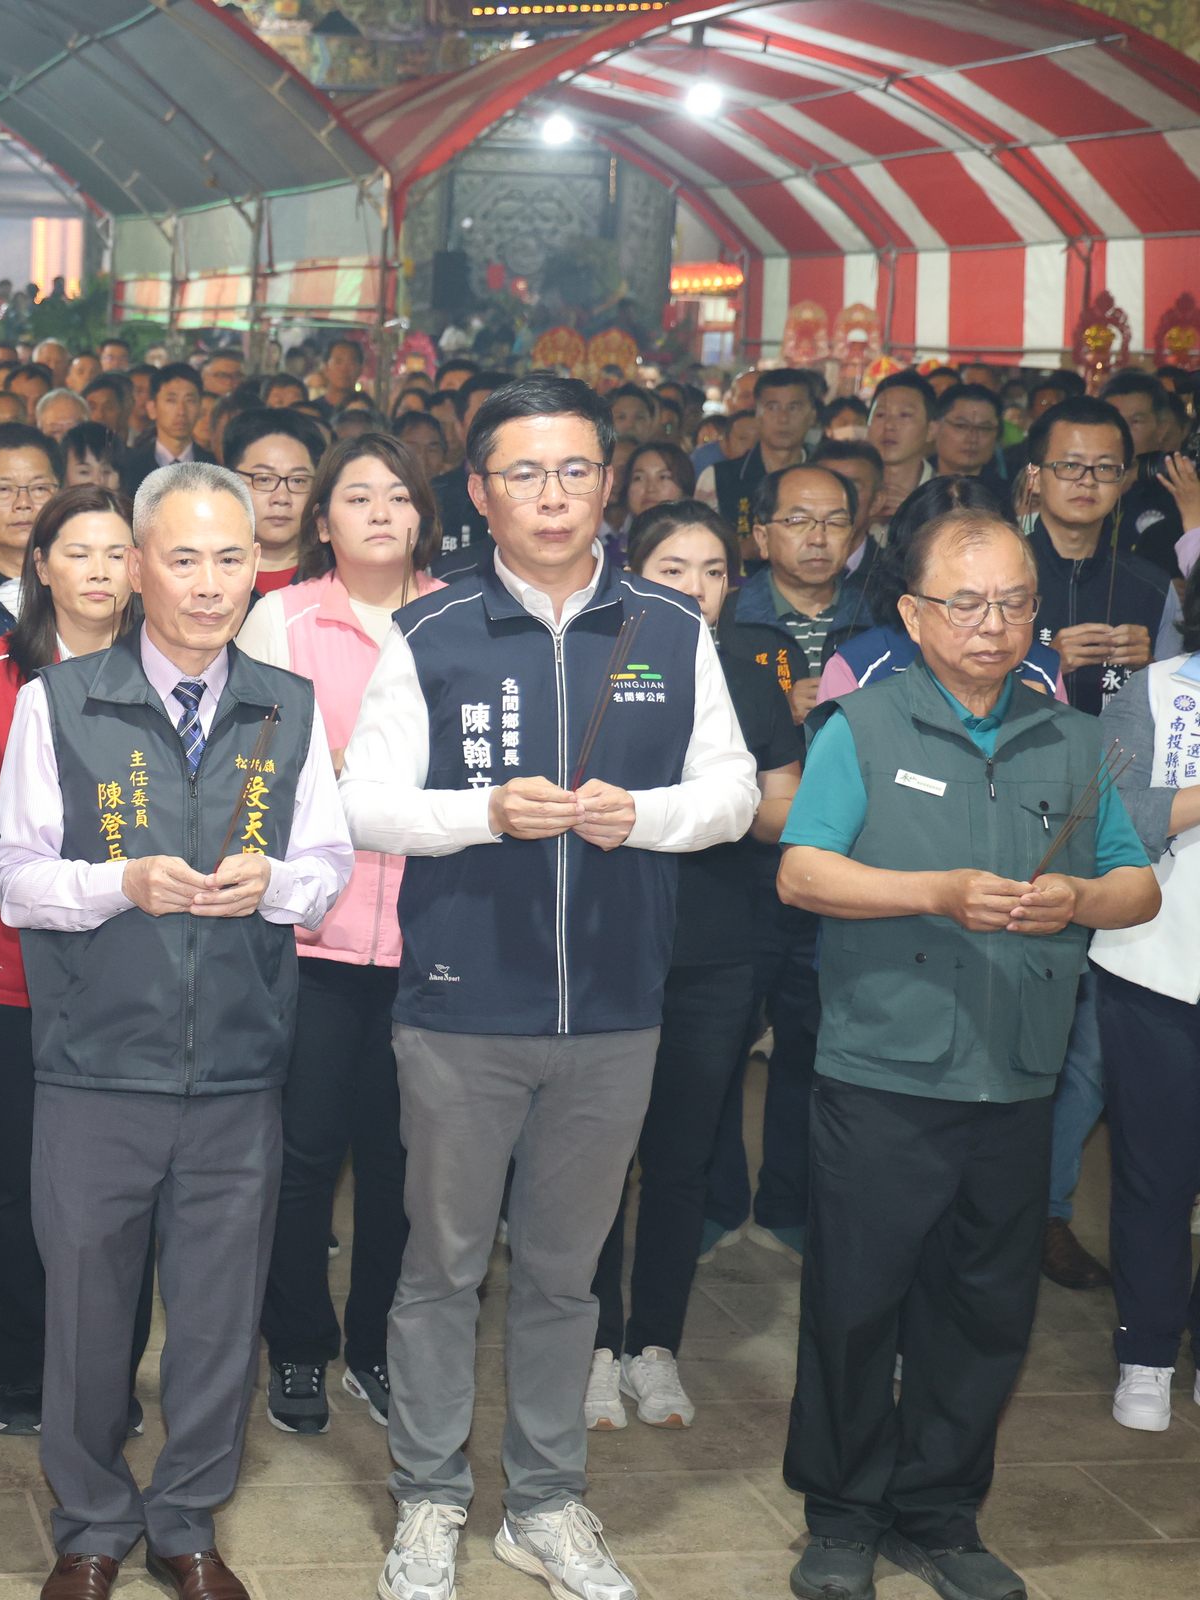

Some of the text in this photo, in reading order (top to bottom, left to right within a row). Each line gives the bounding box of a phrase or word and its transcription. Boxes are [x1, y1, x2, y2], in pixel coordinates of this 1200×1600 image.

[611, 680, 665, 690] MINGJIAN
[612, 691, 666, 704] 名間鄉公所
[501, 677, 520, 767] 名間鄉鄉長
[129, 750, 150, 829] 主任委員
